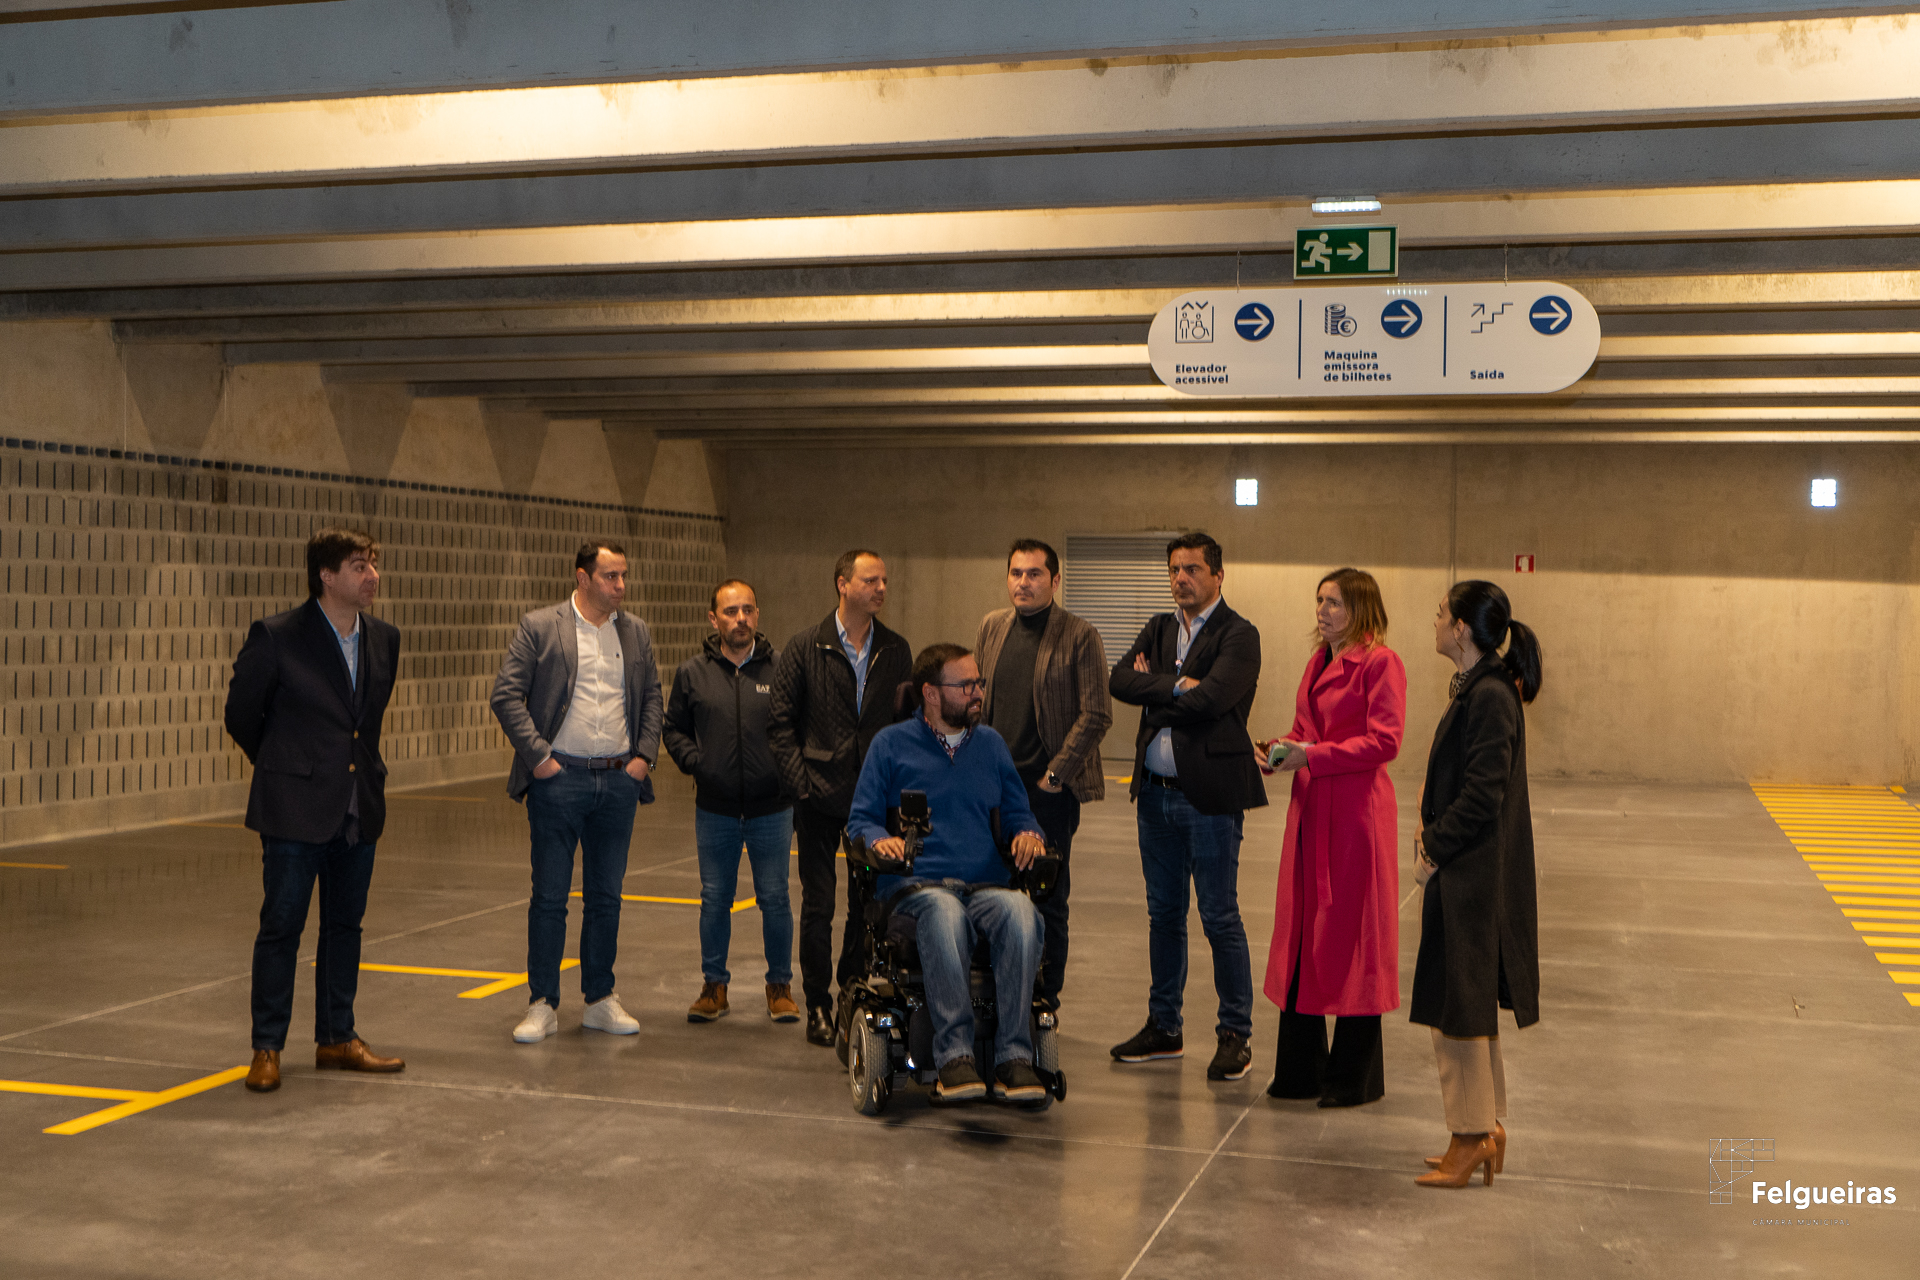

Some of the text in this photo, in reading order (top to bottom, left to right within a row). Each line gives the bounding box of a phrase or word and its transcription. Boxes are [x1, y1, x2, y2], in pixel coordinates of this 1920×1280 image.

[1175, 364, 1227, 373] Elevador
[1324, 361, 1378, 371] emissora
[1324, 372, 1392, 382] de bilhetes
